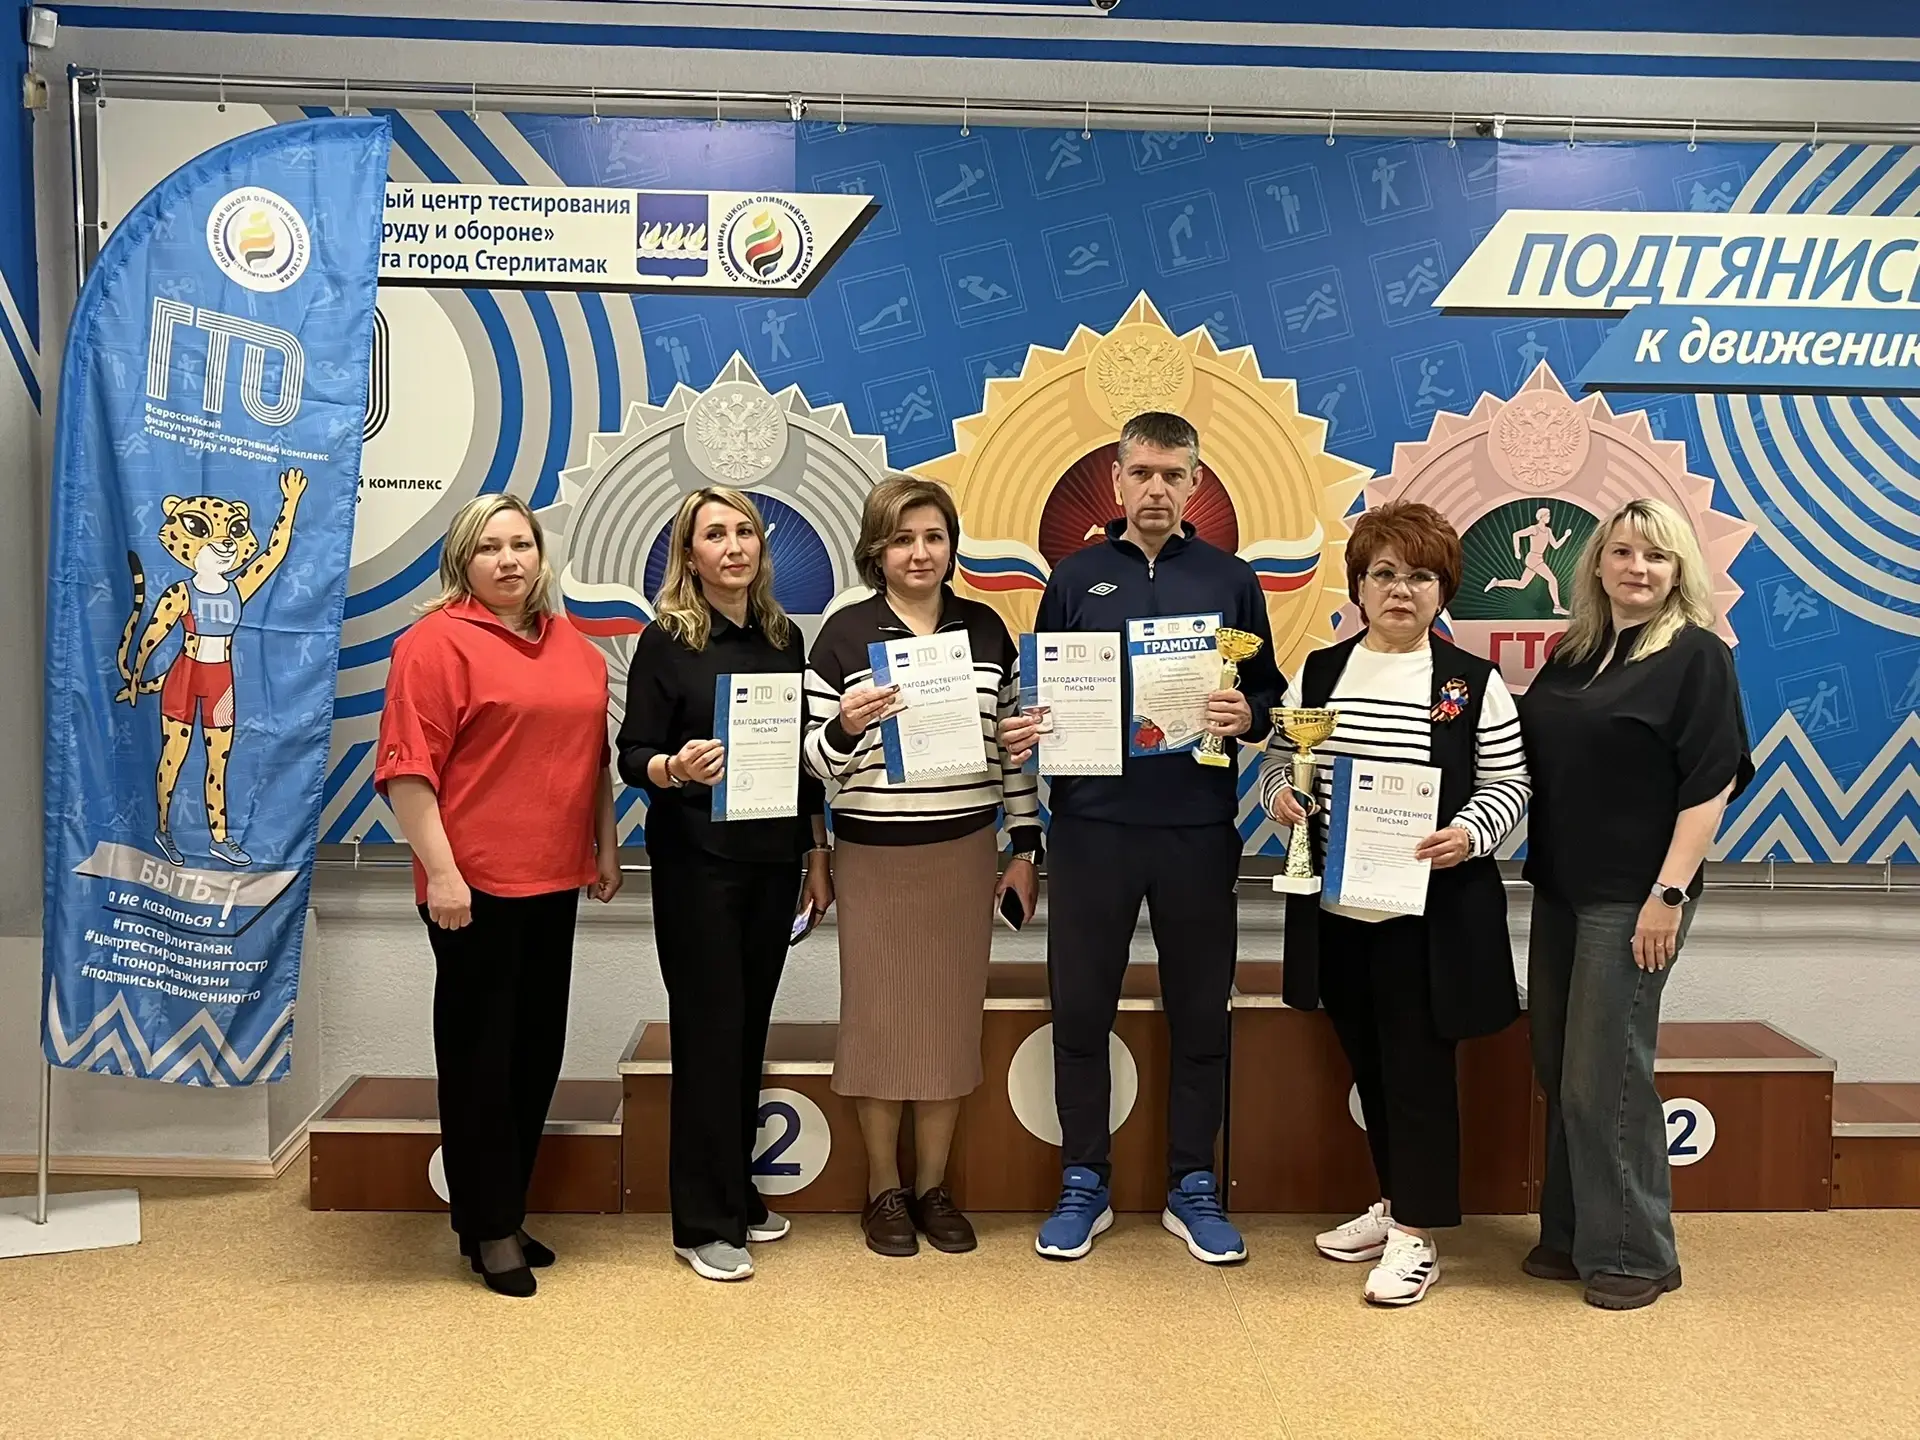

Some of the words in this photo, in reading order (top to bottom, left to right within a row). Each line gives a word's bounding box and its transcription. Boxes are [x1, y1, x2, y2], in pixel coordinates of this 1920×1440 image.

[422, 193, 482, 214] центр
[488, 195, 631, 217] тестирования
[725, 198, 754, 222] ШКОЛА
[756, 196, 813, 243] ОЛИМПИЙСКОГО
[213, 212, 231, 268] СПОРТИВНАЯ
[223, 195, 252, 213] ШКОЛА
[254, 195, 304, 250] ОЛИМПИЙСКОГО
[435, 224, 447, 239] и
[454, 220, 555, 245] обороне»
[408, 253, 469, 274] город
[475, 249, 608, 278] Стерлитамак
[717, 223, 739, 282] СПОРТИВНАЯ
[791, 245, 813, 284] РЕЗЕРВА
[146, 296, 305, 427] ГТО
[1634, 328, 1669, 363] к
[145, 402, 221, 430] Всероссийский
[144, 413, 279, 455] физкультурно-спортивный
[281, 446, 329, 462] комплекс
[144, 425, 177, 442] «Готов
[179, 434, 186, 444] к
[188, 437, 217, 453] труду
[220, 444, 226, 453] и
[229, 446, 277, 463] обороне»
[369, 477, 443, 490] комплекс
[1066, 644, 1087, 658] ГТО
[1143, 638, 1209, 654] ГРАМОТА
[902, 674, 971, 689] ЛАГОДАРСТВЕННОЕ
[920, 685, 951, 695] ПИСЬМО
[733, 717, 797, 725] БЛАГОДАРСТВЕННОЕ
[1381, 775, 1405, 791] ГТО
[1354, 805, 1433, 820] БЛАГОДАРСТВЕННОЕ
[1376, 816, 1409, 826] ПИСЬМО
[139, 858, 216, 905] БЫТЬ,
[108, 890, 116, 903] а
[118, 892, 140, 907] не
[142, 896, 212, 928] казаться
[84, 929, 268, 973] #центртестированиягтостр
[113, 918, 233, 955] #гтостерлитамак
[81, 965, 261, 1004] #подтяниськдвижениюгто
[112, 952, 230, 987] #гтонормажизни
[751, 1101, 801, 1176] 2
[1667, 1109, 1697, 1155] 2
